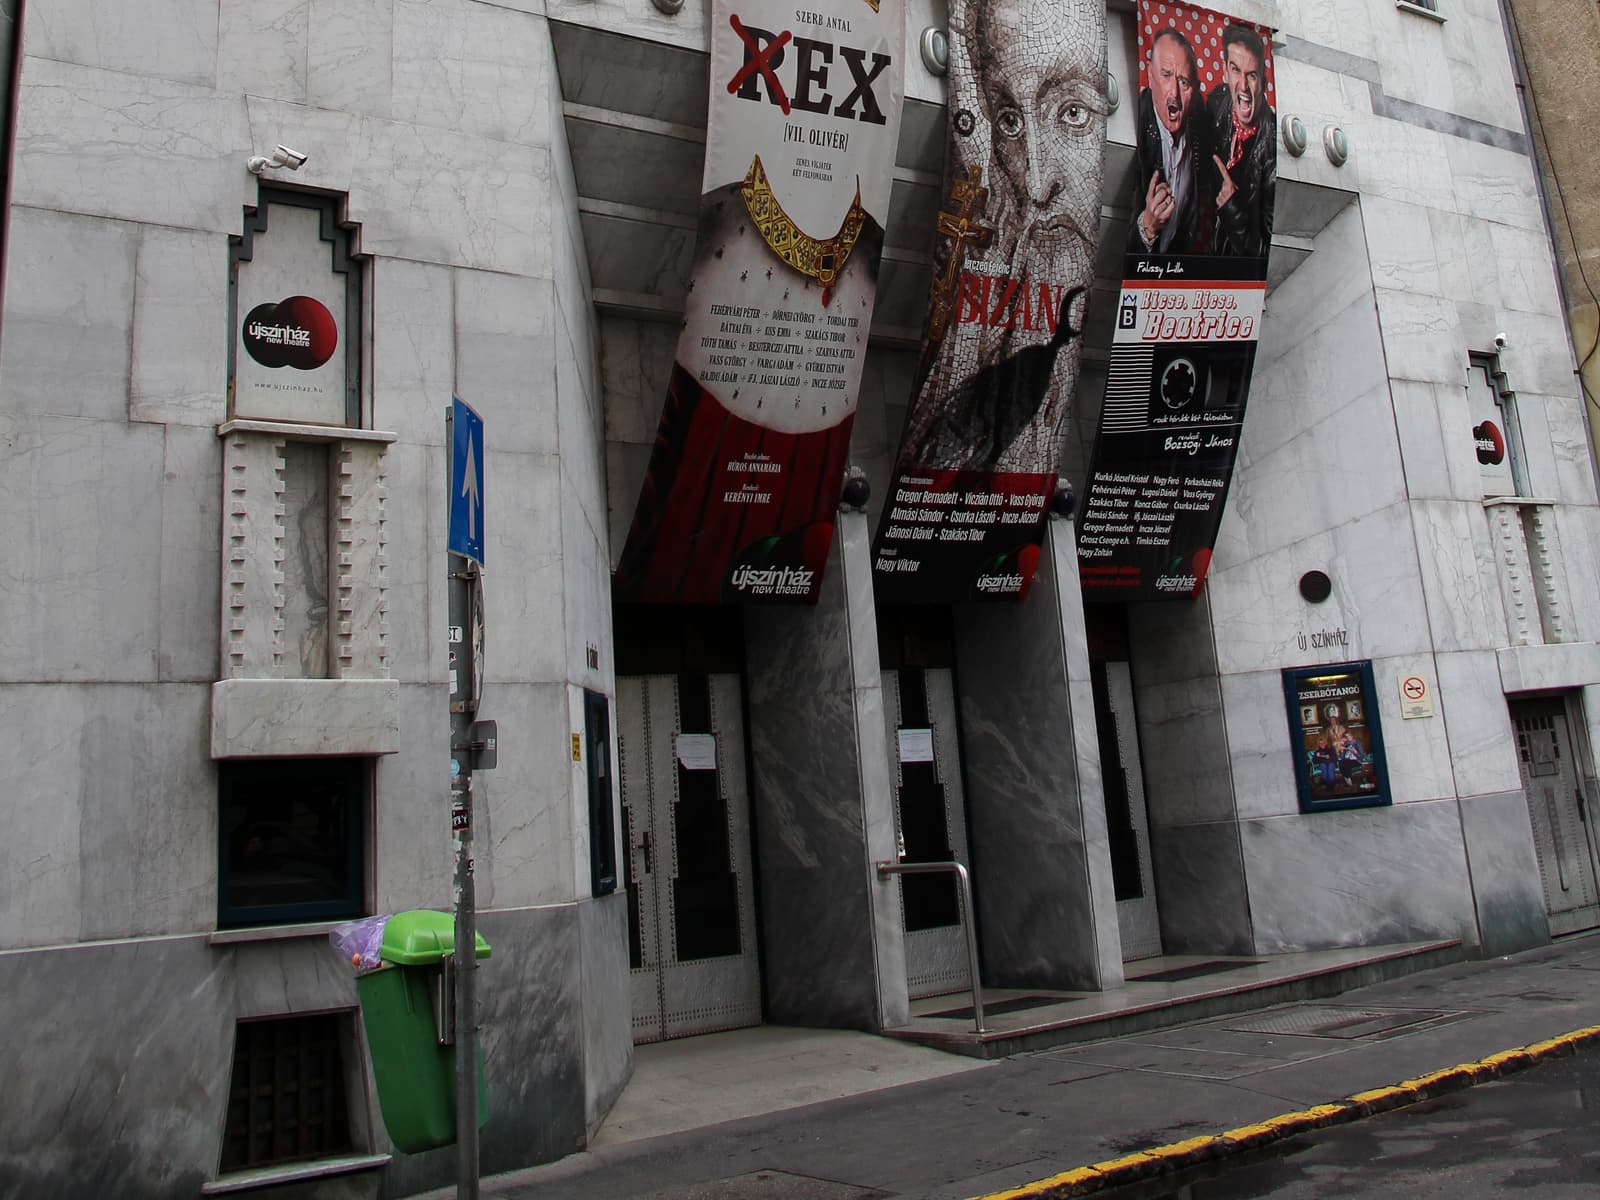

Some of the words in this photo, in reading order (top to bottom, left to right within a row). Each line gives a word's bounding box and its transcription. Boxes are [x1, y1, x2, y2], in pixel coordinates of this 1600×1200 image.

[795, 10, 824, 26] SZERB
[826, 17, 852, 32] ANTAL
[733, 22, 892, 126] REX
[249, 321, 311, 341] újszínház
[1142, 310, 1254, 340] Beatrice
[266, 336, 283, 345] new
[284, 338, 311, 348] theatre
[1205, 434, 1233, 448] János
[1153, 476, 1167, 486] Nagy
[1121, 486, 1137, 495] Péter
[896, 488, 922, 504] Gregor
[922, 490, 959, 505] Bernadett
[989, 493, 1004, 506] Ottó
[1009, 494, 1025, 506] Vass
[1025, 494, 1046, 508] György
[1089, 497, 1113, 507] Szakács
[1113, 498, 1129, 508] Tibor
[890, 507, 917, 522] Almási
[917, 509, 944, 523] Sándor
[950, 510, 975, 523] Csurka
[975, 510, 997, 524] László
[1001, 511, 1019, 524] Incze
[1019, 511, 1040, 525] József
[1107, 511, 1129, 520] Sándor
[885, 525, 912, 540] Jánosi
[912, 526, 934, 540] Dávid
[939, 528, 968, 541] Szakács
[968, 529, 986, 541] Tibor
[1083, 522, 1105, 533] Gregor
[1105, 523, 1134, 533] Bernadett
[1080, 535, 1098, 544] Orosz
[1077, 548, 1093, 558] Nagy
[876, 558, 897, 572] Nagy
[897, 559, 921, 572] Viktor
[731, 564, 814, 591] újszínház
[752, 585, 774, 594] new
[775, 583, 810, 595] theatre
[1297, 632, 1308, 651] ÚJ
[1312, 628, 1349, 649] SZÍNHÁZ
